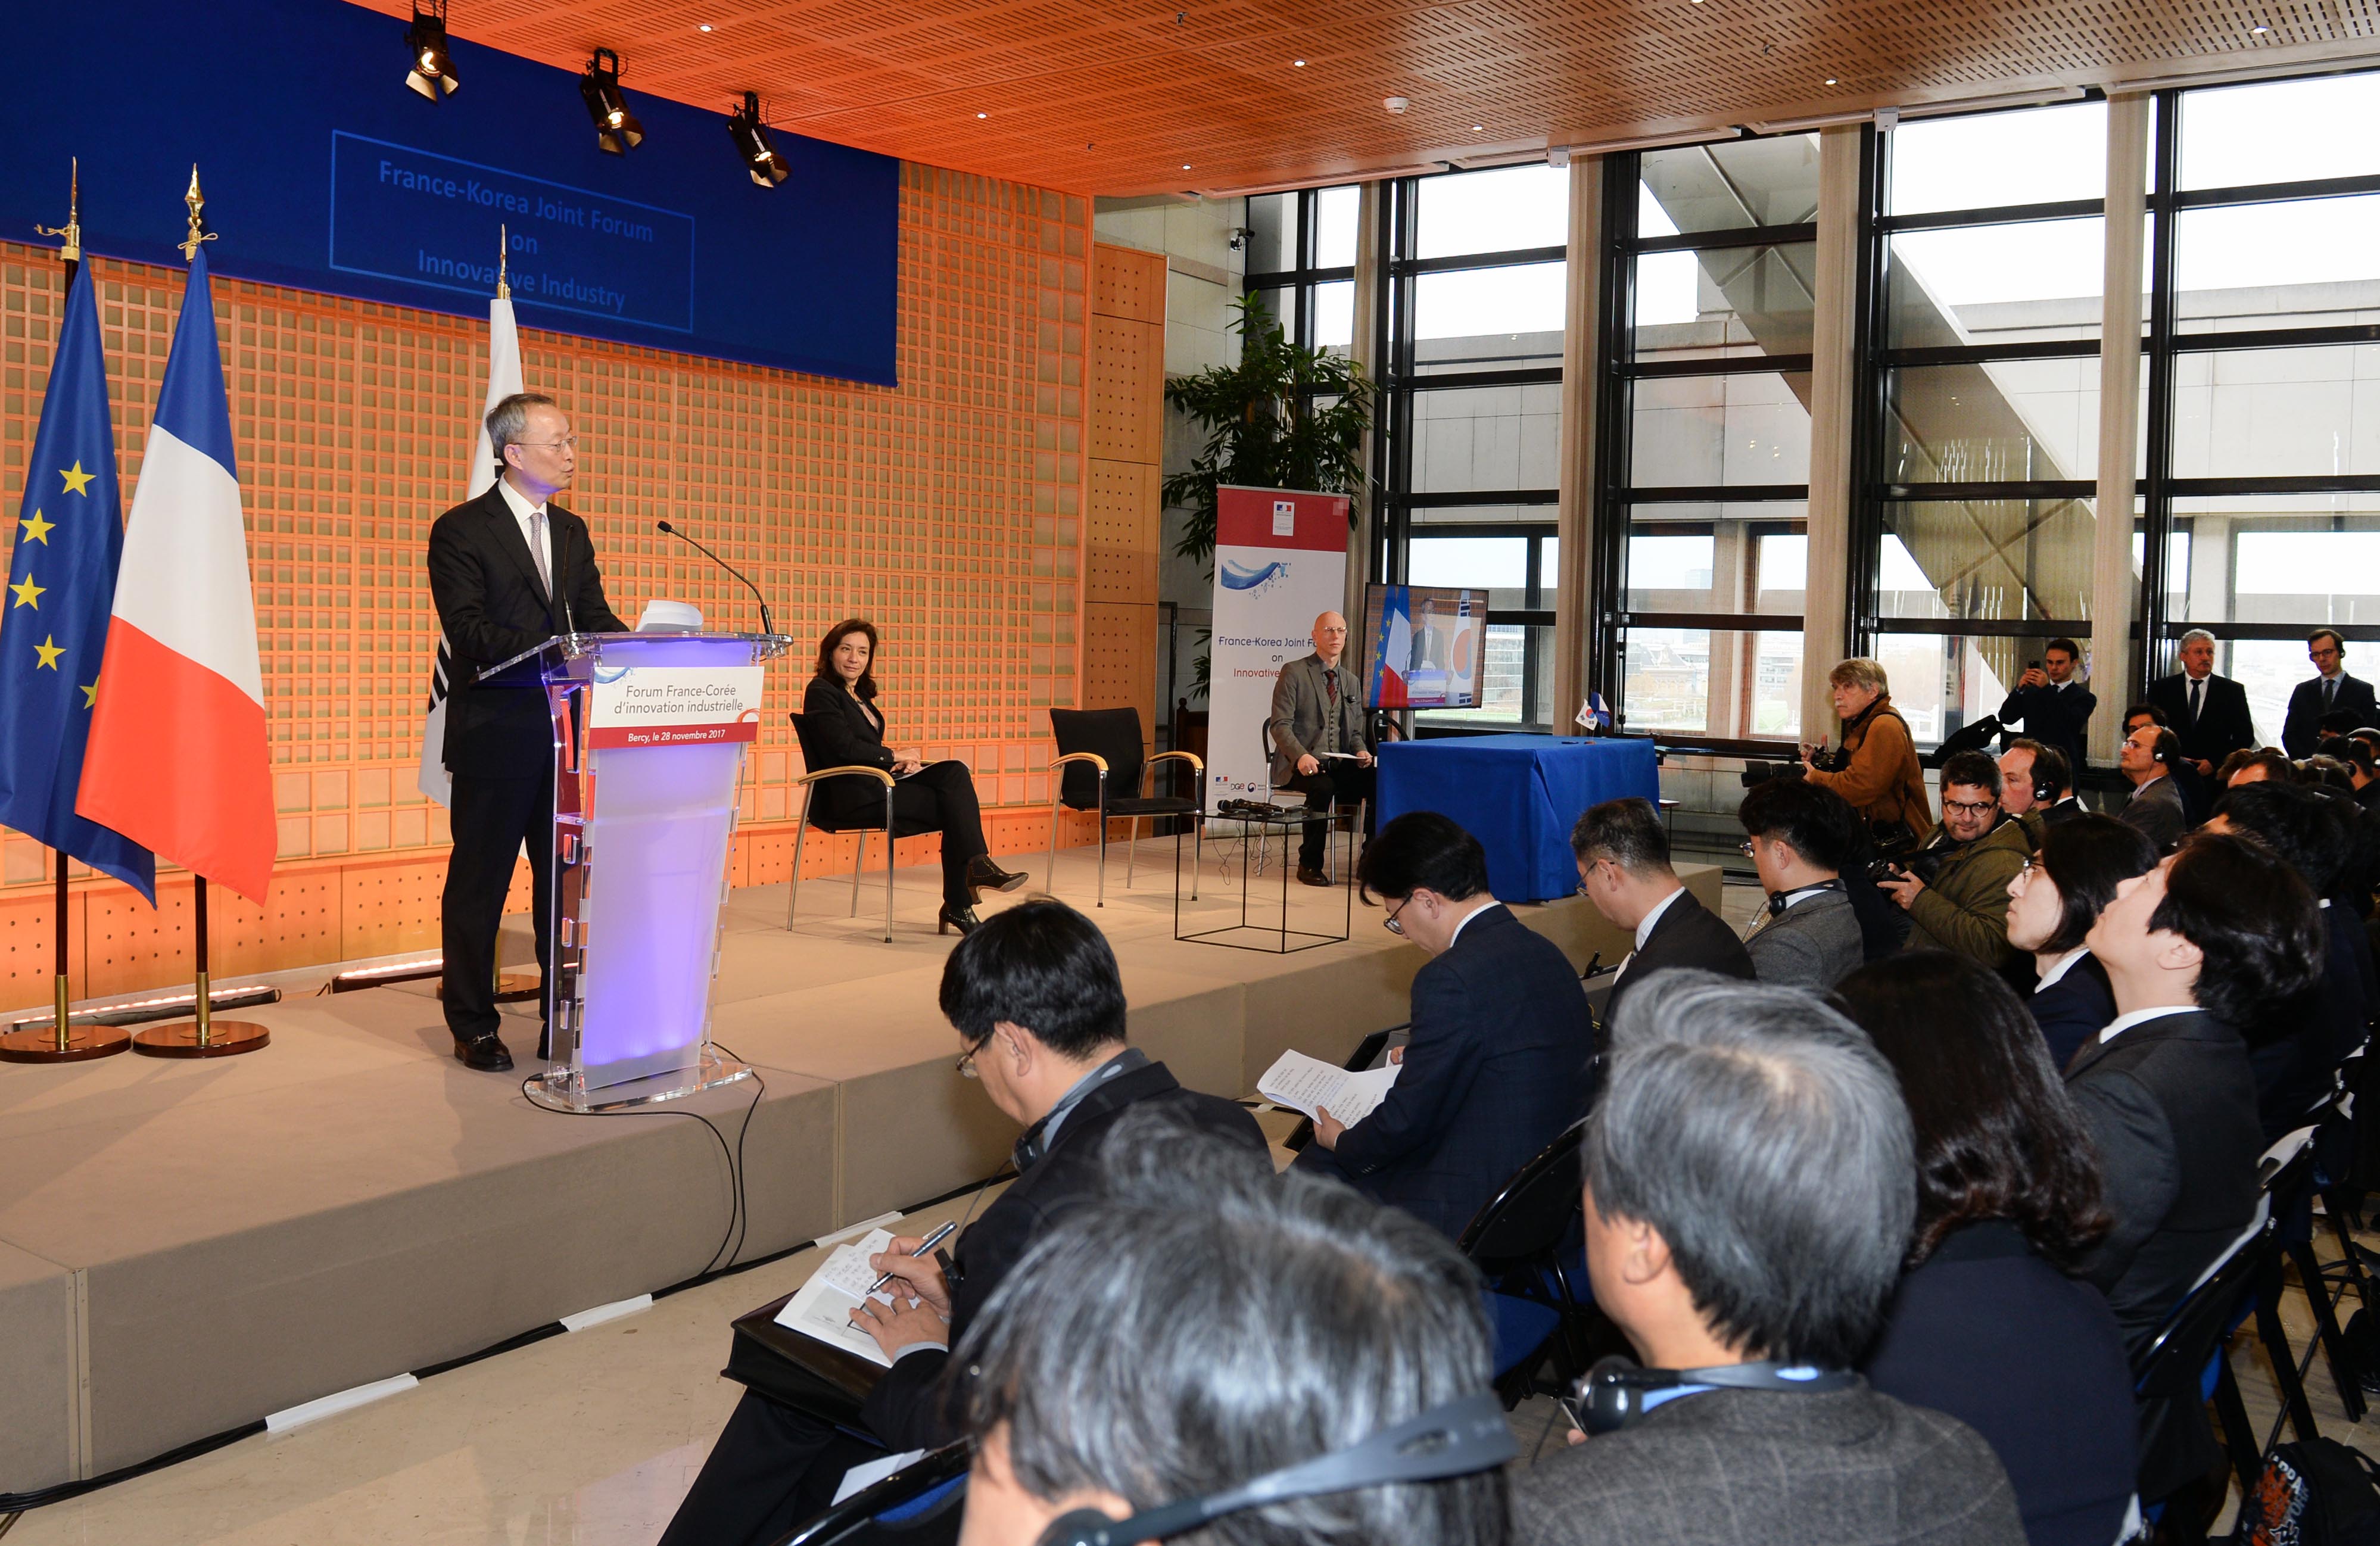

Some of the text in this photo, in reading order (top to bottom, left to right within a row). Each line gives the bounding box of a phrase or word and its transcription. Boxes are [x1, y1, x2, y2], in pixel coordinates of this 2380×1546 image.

[379, 160, 653, 243] France-Korea Joint Forum
[512, 233, 537, 255] on
[542, 273, 625, 314] Industry
[1219, 637, 1282, 647] France-Korea
[1284, 638, 1305, 647] Joint
[1233, 668, 1281, 678] Innovative
[627, 684, 736, 697] Forum France-Corée
[614, 699, 743, 715] d'innovation industrielle
[628, 729, 725, 744] Bercy, le 28 novembre 2017
